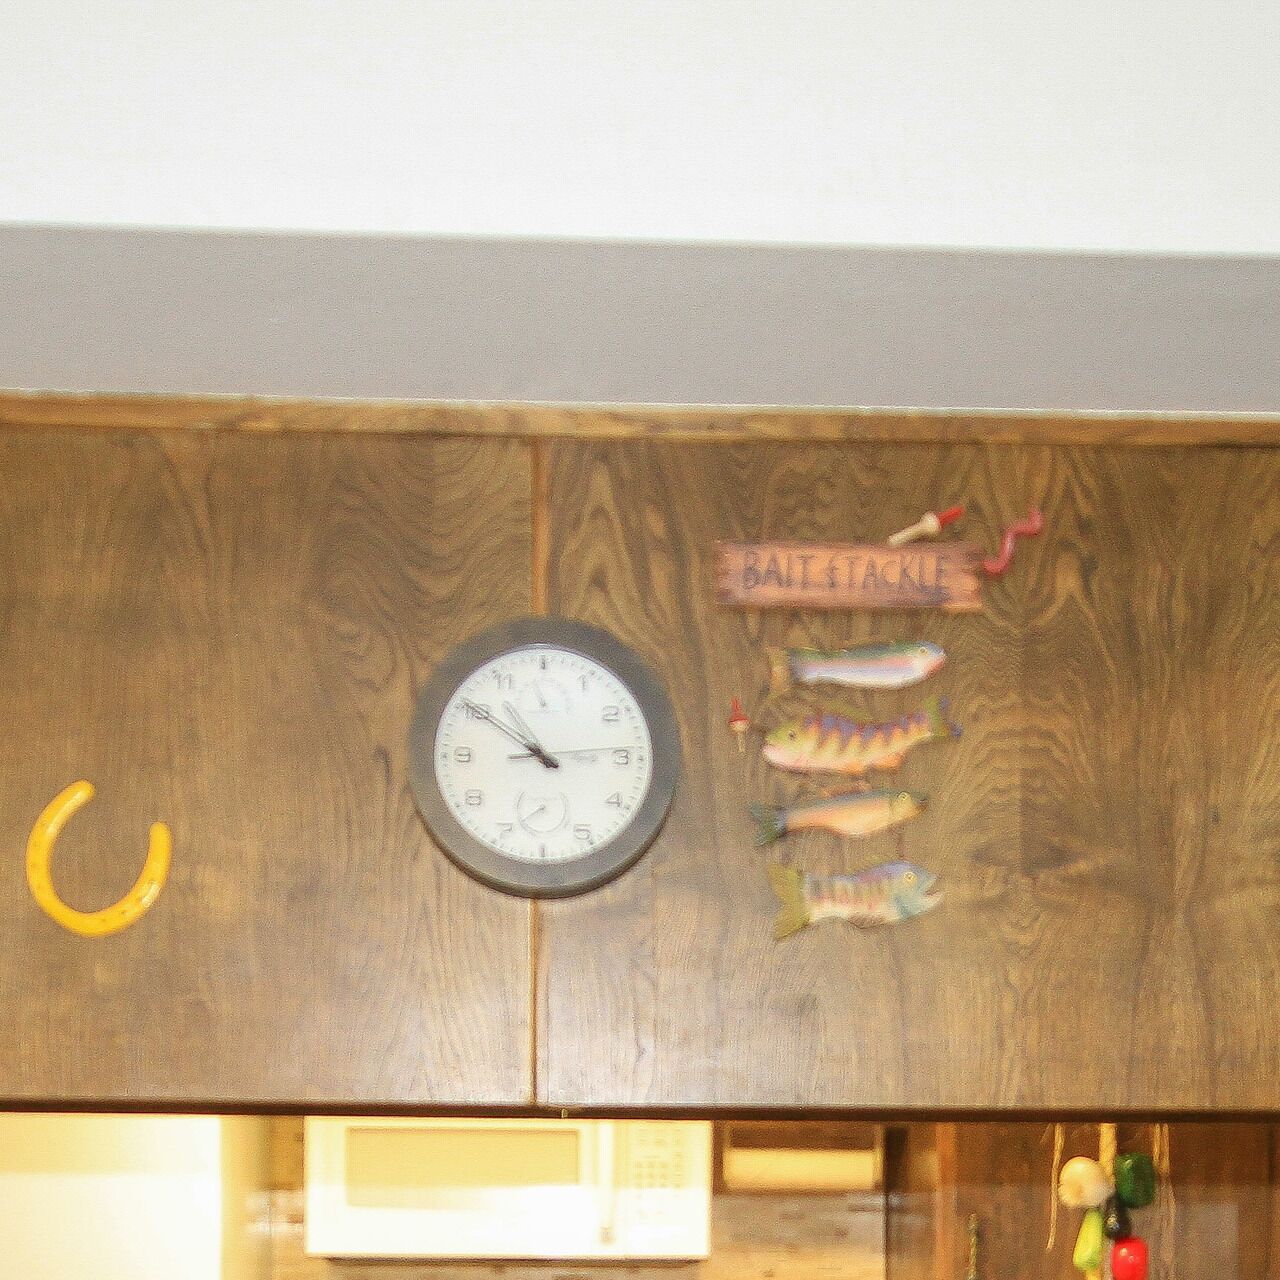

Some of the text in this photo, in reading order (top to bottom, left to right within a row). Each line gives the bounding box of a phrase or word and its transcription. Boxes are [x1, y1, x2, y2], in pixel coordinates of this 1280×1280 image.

[741, 551, 816, 590] BAIT
[494, 673, 513, 690] 11
[578, 673, 588, 691] 1
[602, 705, 620, 722] 2
[453, 746, 472, 764] 9
[611, 748, 630, 766] 3
[464, 788, 483, 806] 8
[604, 791, 623, 807] 4
[496, 821, 513, 840] 7
[573, 823, 592, 841] 5
